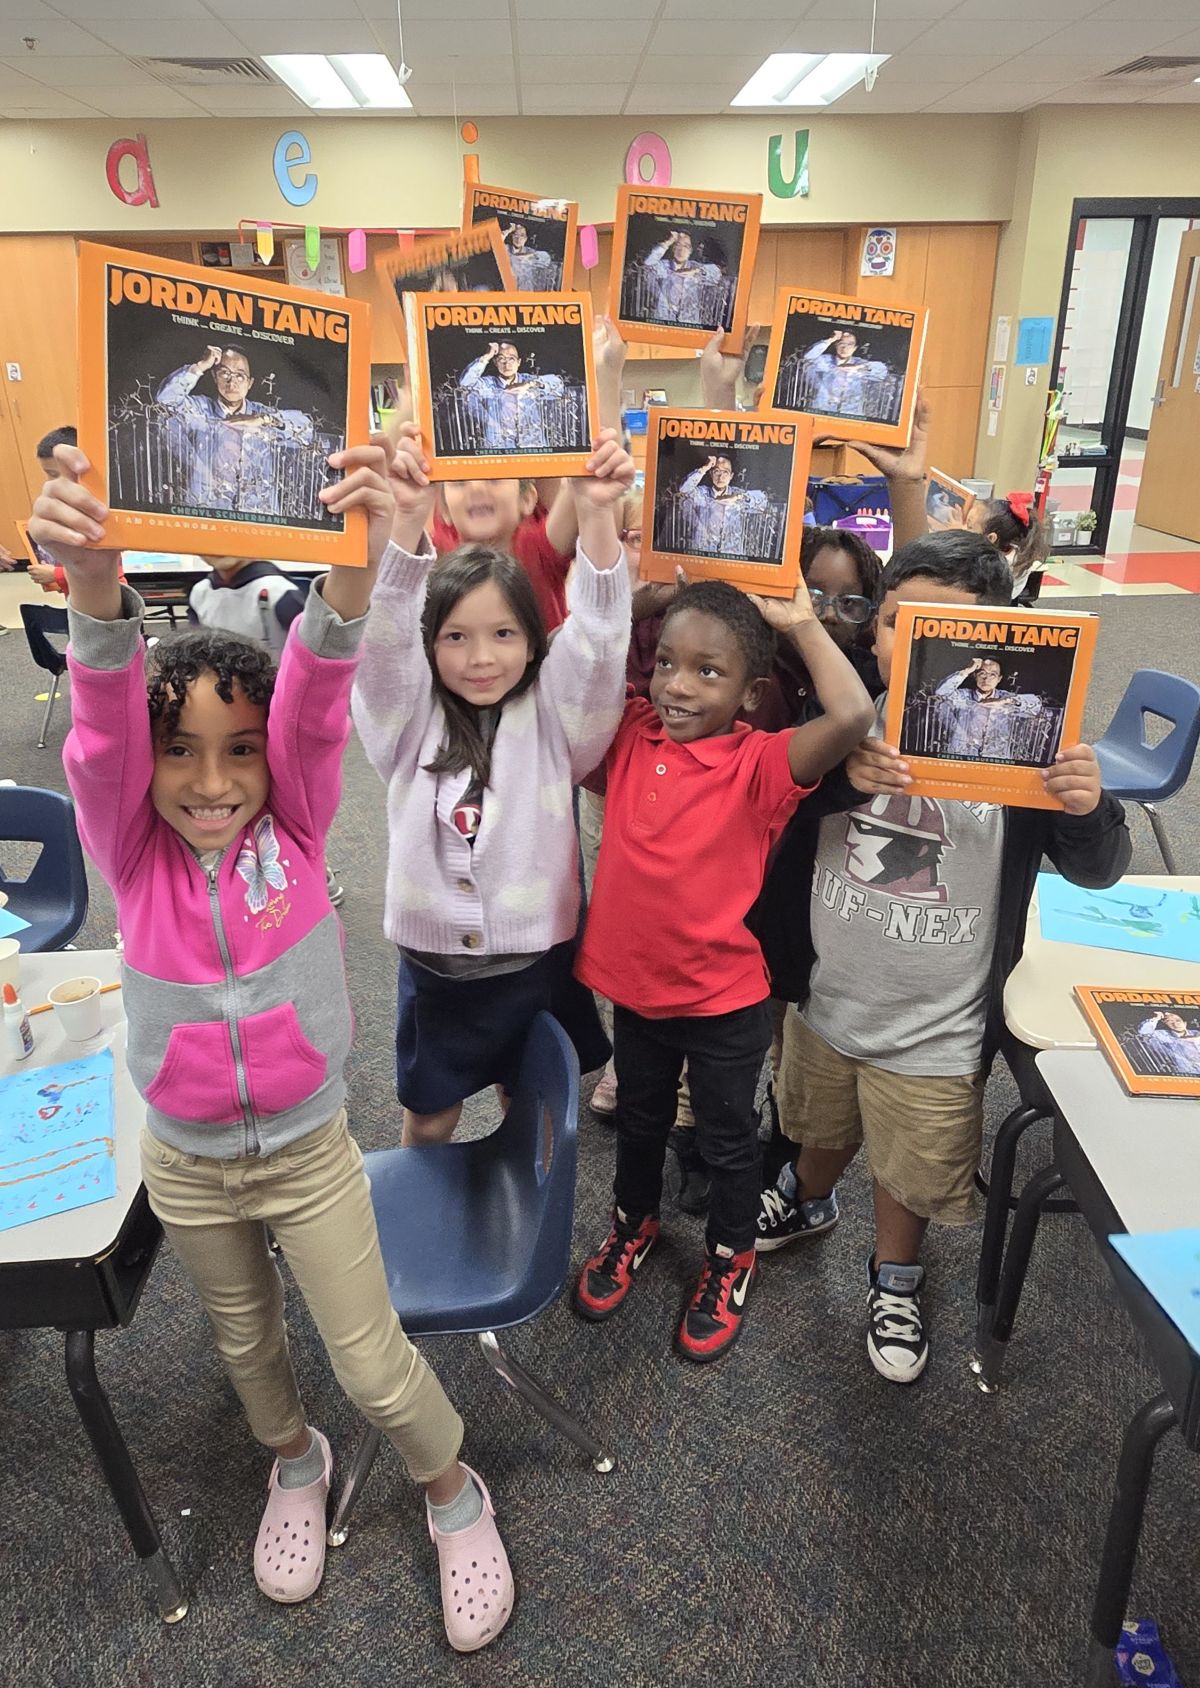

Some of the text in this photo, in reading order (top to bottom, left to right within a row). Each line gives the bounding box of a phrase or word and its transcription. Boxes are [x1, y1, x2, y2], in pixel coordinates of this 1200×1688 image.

[106, 133, 160, 208] a
[273, 130, 318, 207] e
[625, 131, 672, 186] o
[768, 129, 809, 199] u
[474, 191, 529, 213] JORDAN
[629, 195, 697, 217] JORDAN
[698, 203, 746, 222] TANG
[109, 268, 347, 344] JORDAN TANG
[426, 305, 581, 330] JORDAN TANG
[789, 297, 862, 320] JORDAN
[864, 308, 913, 328] TANG
[172, 313, 295, 346] THINK CREATE DISCOVER
[659, 419, 736, 441] JORDAN
[739, 424, 794, 445] TANG
[170, 506, 288, 525] CHERYL SCHUERMANN
[913, 618, 1077, 648] JORDAN TANG
[1093, 991, 1172, 1004] JORDAN
